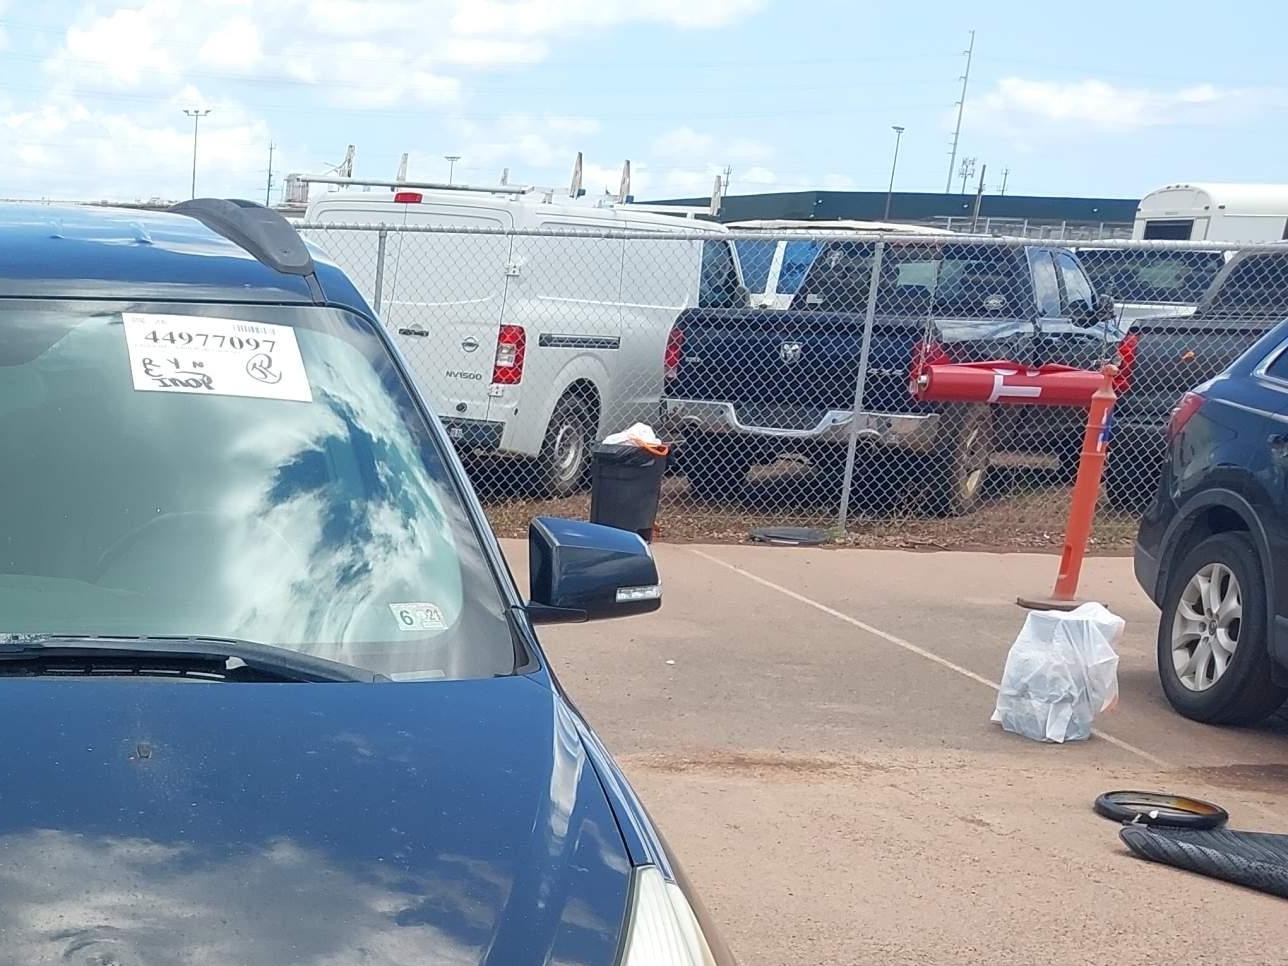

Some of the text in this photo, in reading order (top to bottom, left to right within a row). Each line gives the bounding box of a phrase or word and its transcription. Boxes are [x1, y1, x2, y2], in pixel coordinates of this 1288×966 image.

[144, 331, 276, 353] 44977097
[445, 370, 483, 381] NV1500
[400, 610, 414, 626] 6
